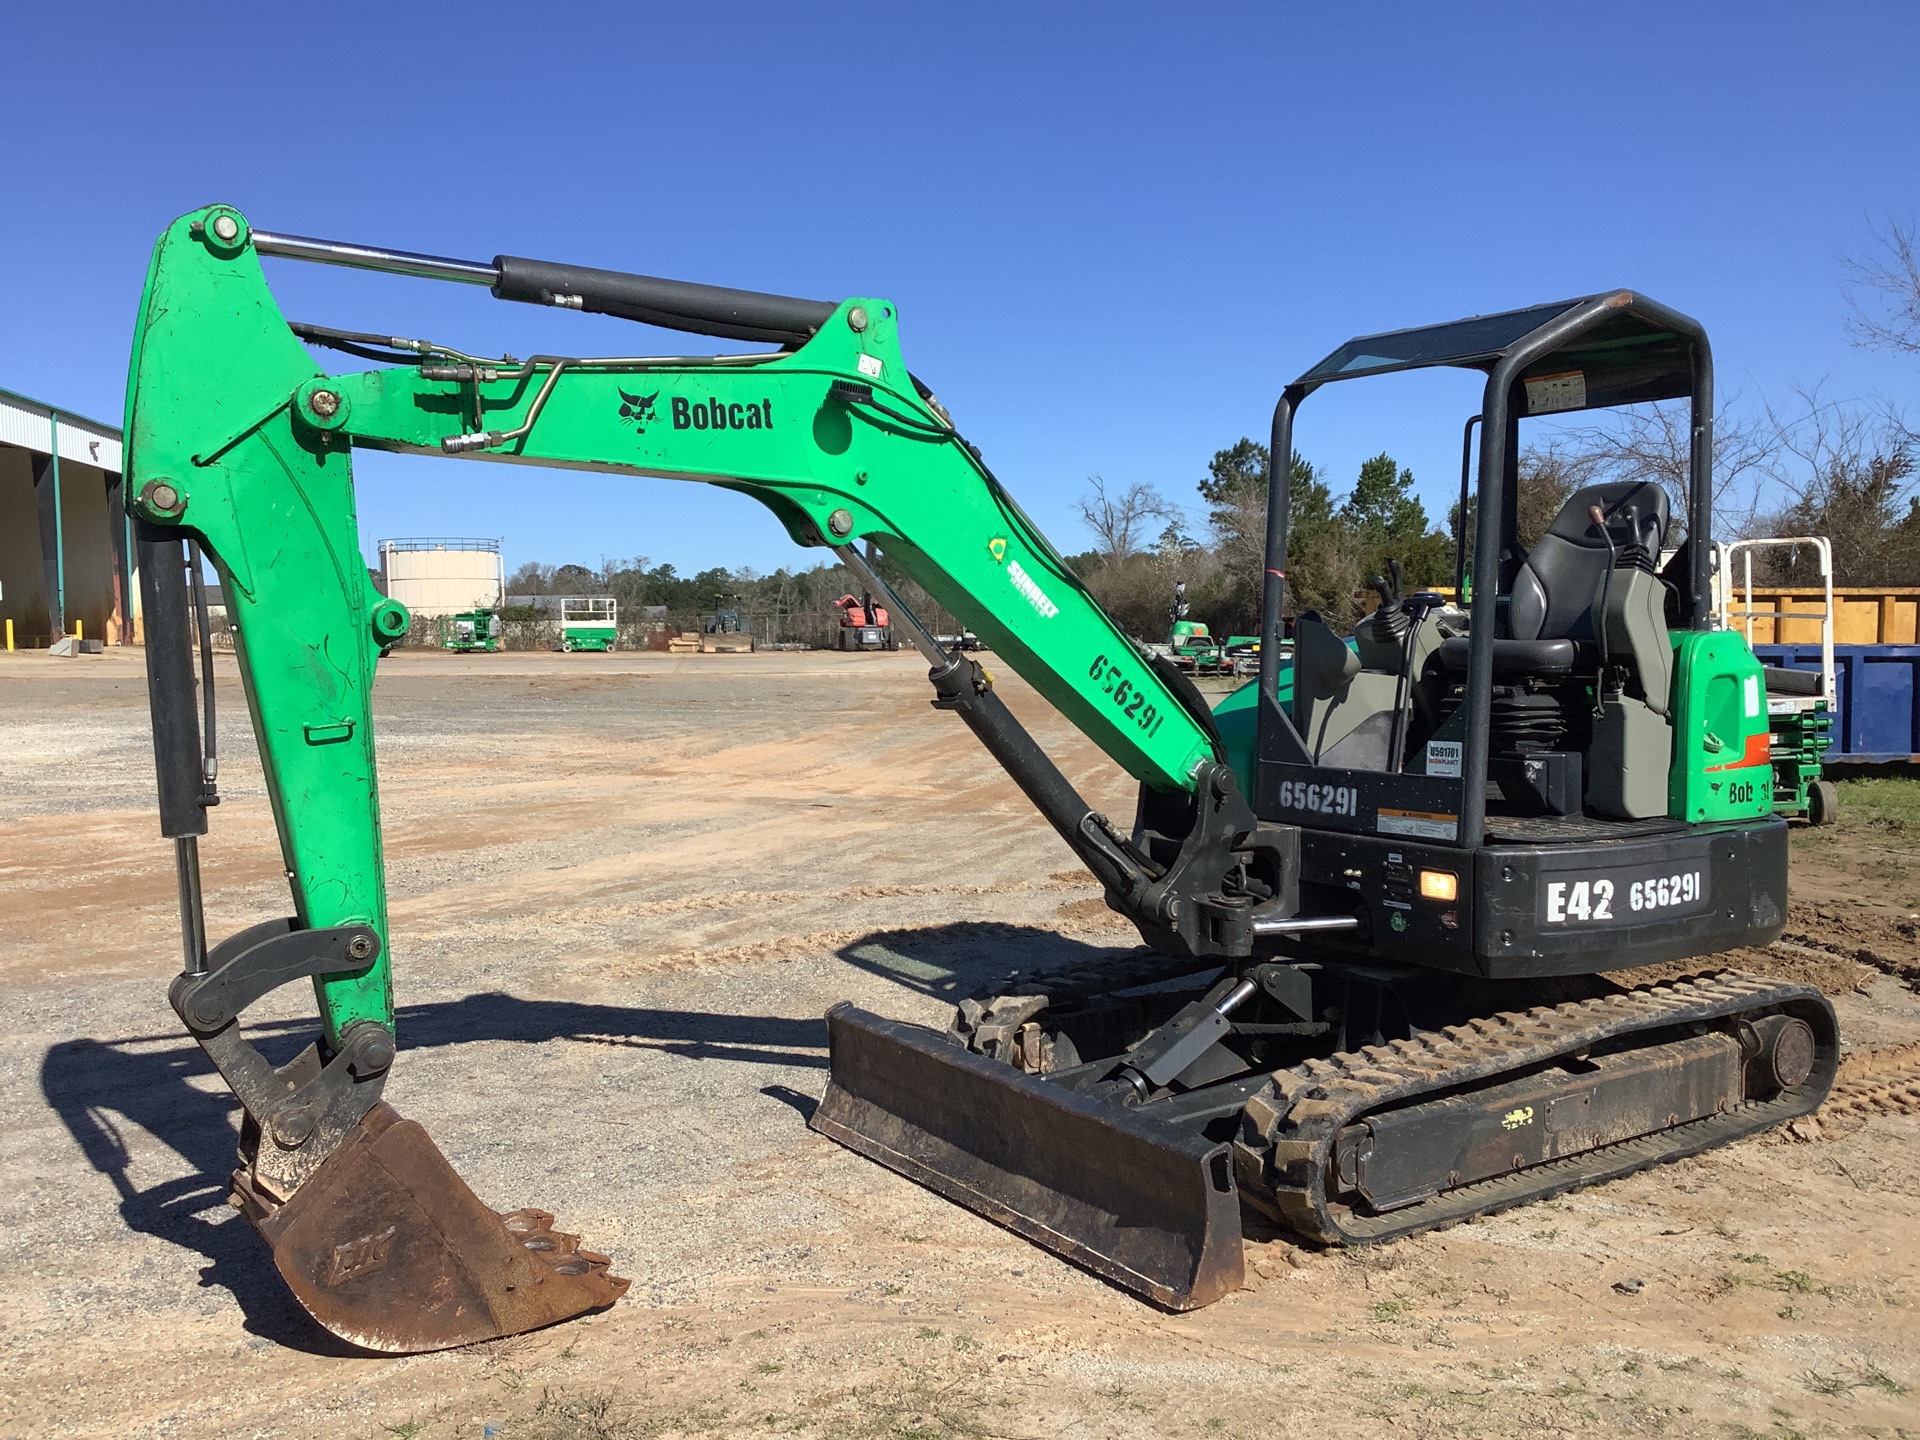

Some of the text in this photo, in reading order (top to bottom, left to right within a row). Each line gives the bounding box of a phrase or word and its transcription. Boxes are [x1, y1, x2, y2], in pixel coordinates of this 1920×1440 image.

[671, 396, 774, 430] Bobcat
[1007, 559, 1060, 618] SUNBELT
[1089, 654, 1165, 739] 656291
[1280, 780, 1357, 817] 656291
[1547, 871, 1700, 923] E42 656291
